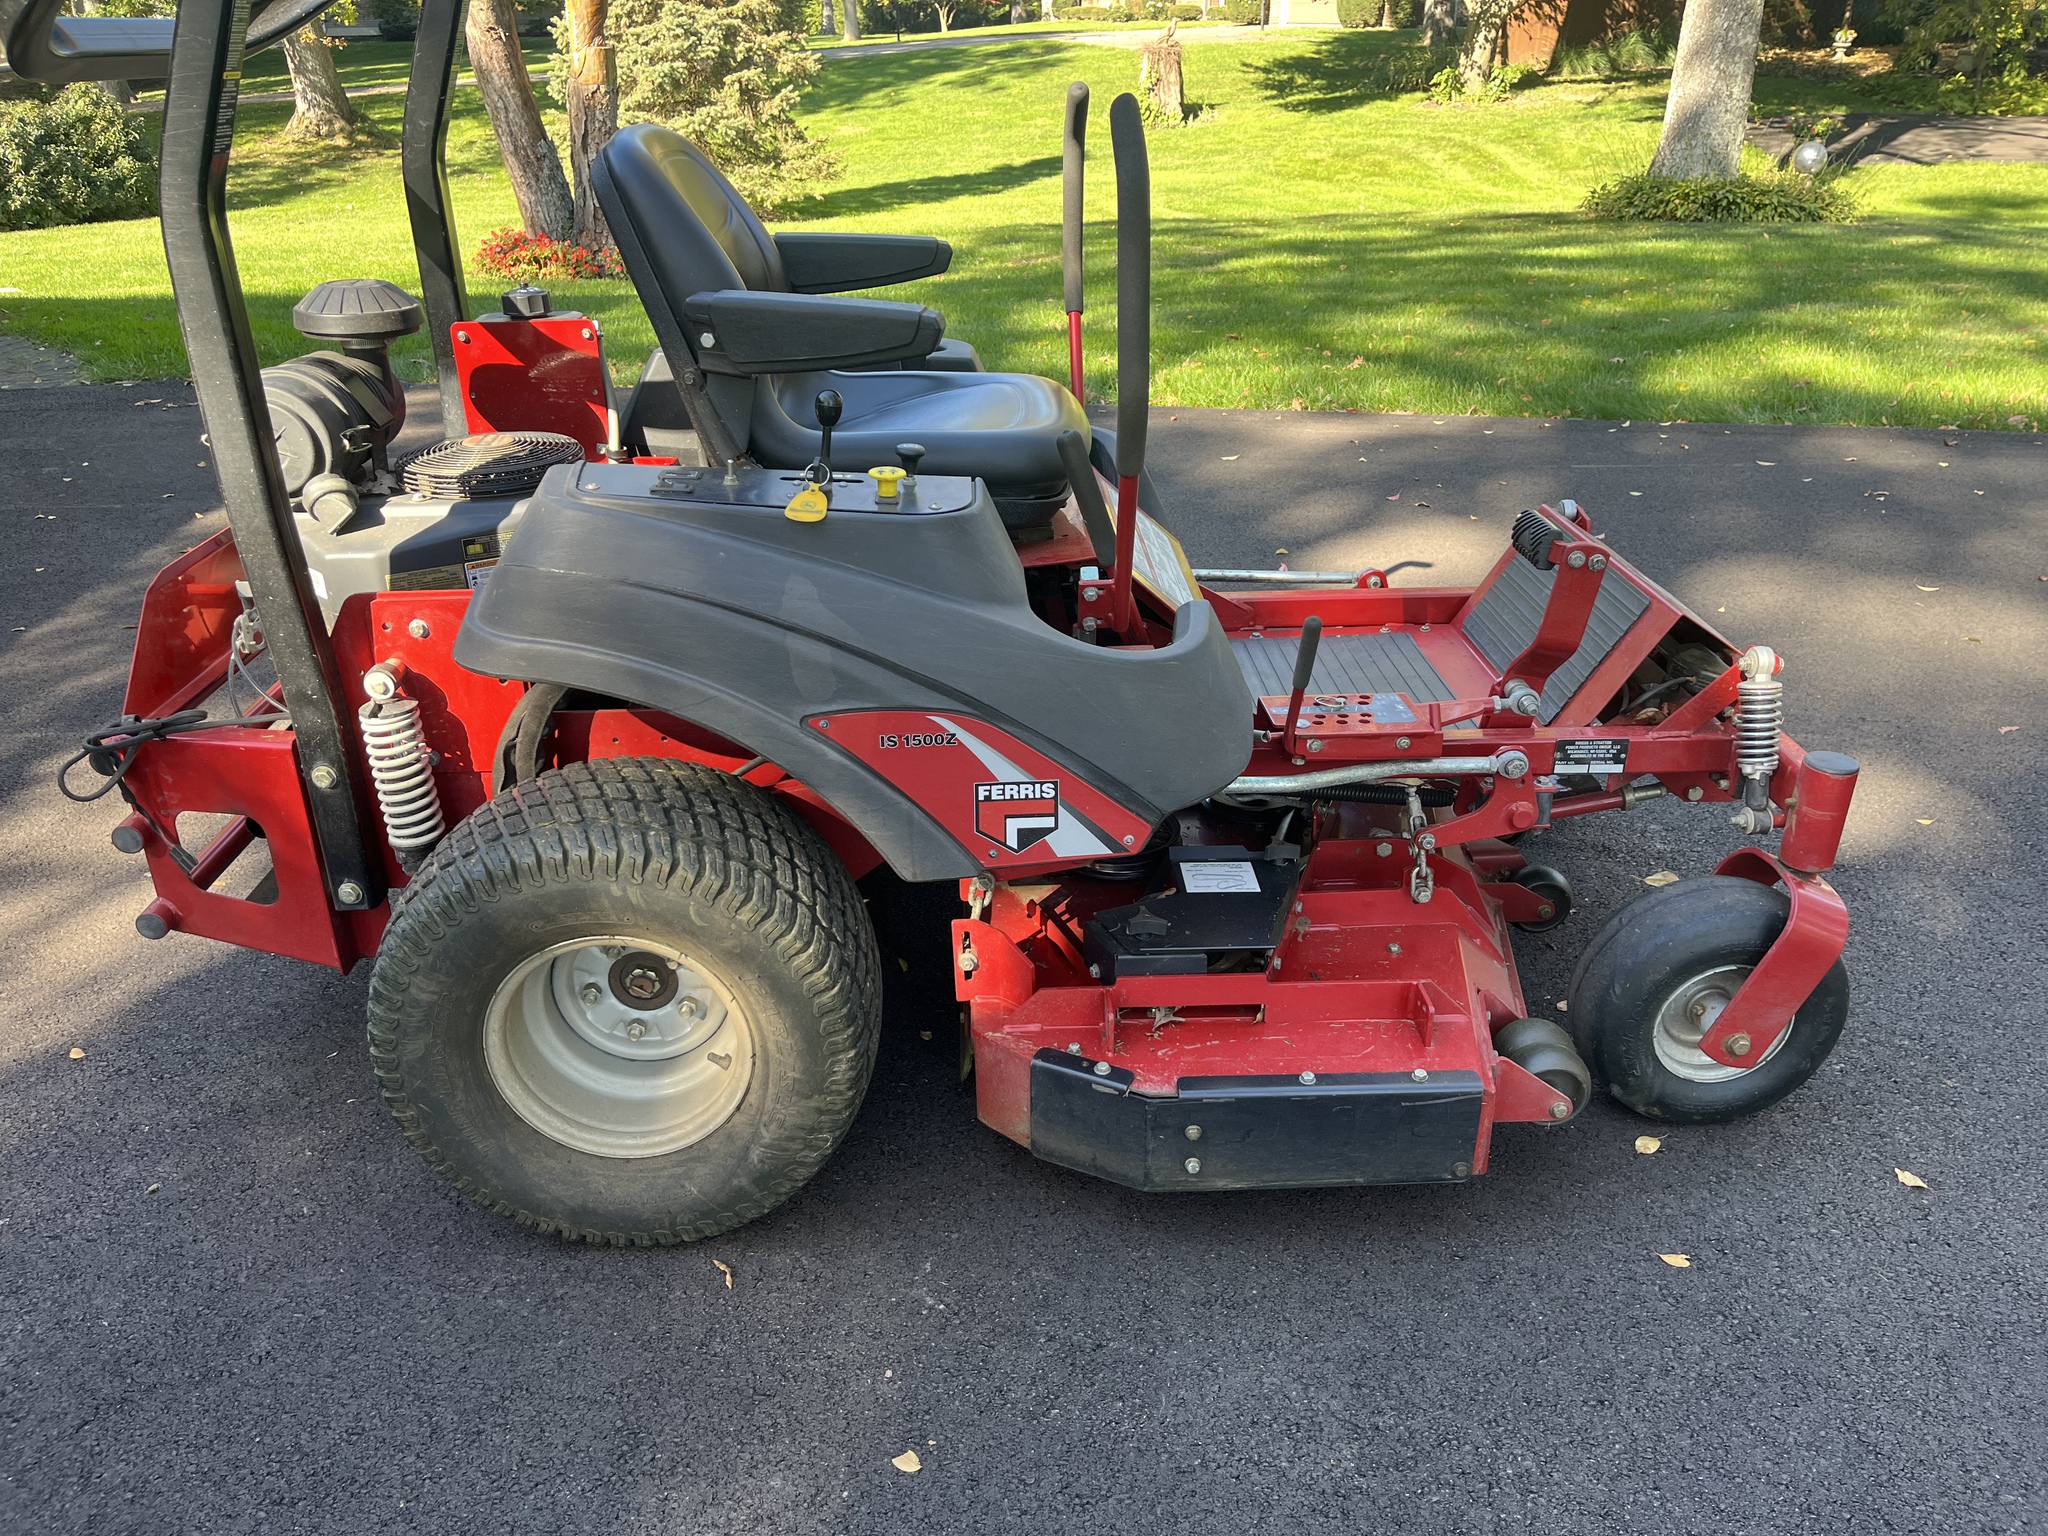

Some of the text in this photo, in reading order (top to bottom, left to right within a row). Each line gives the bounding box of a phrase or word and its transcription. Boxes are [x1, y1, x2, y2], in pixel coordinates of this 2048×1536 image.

[879, 732, 958, 748] IS 1500Z
[978, 783, 1056, 801] FERRIS
